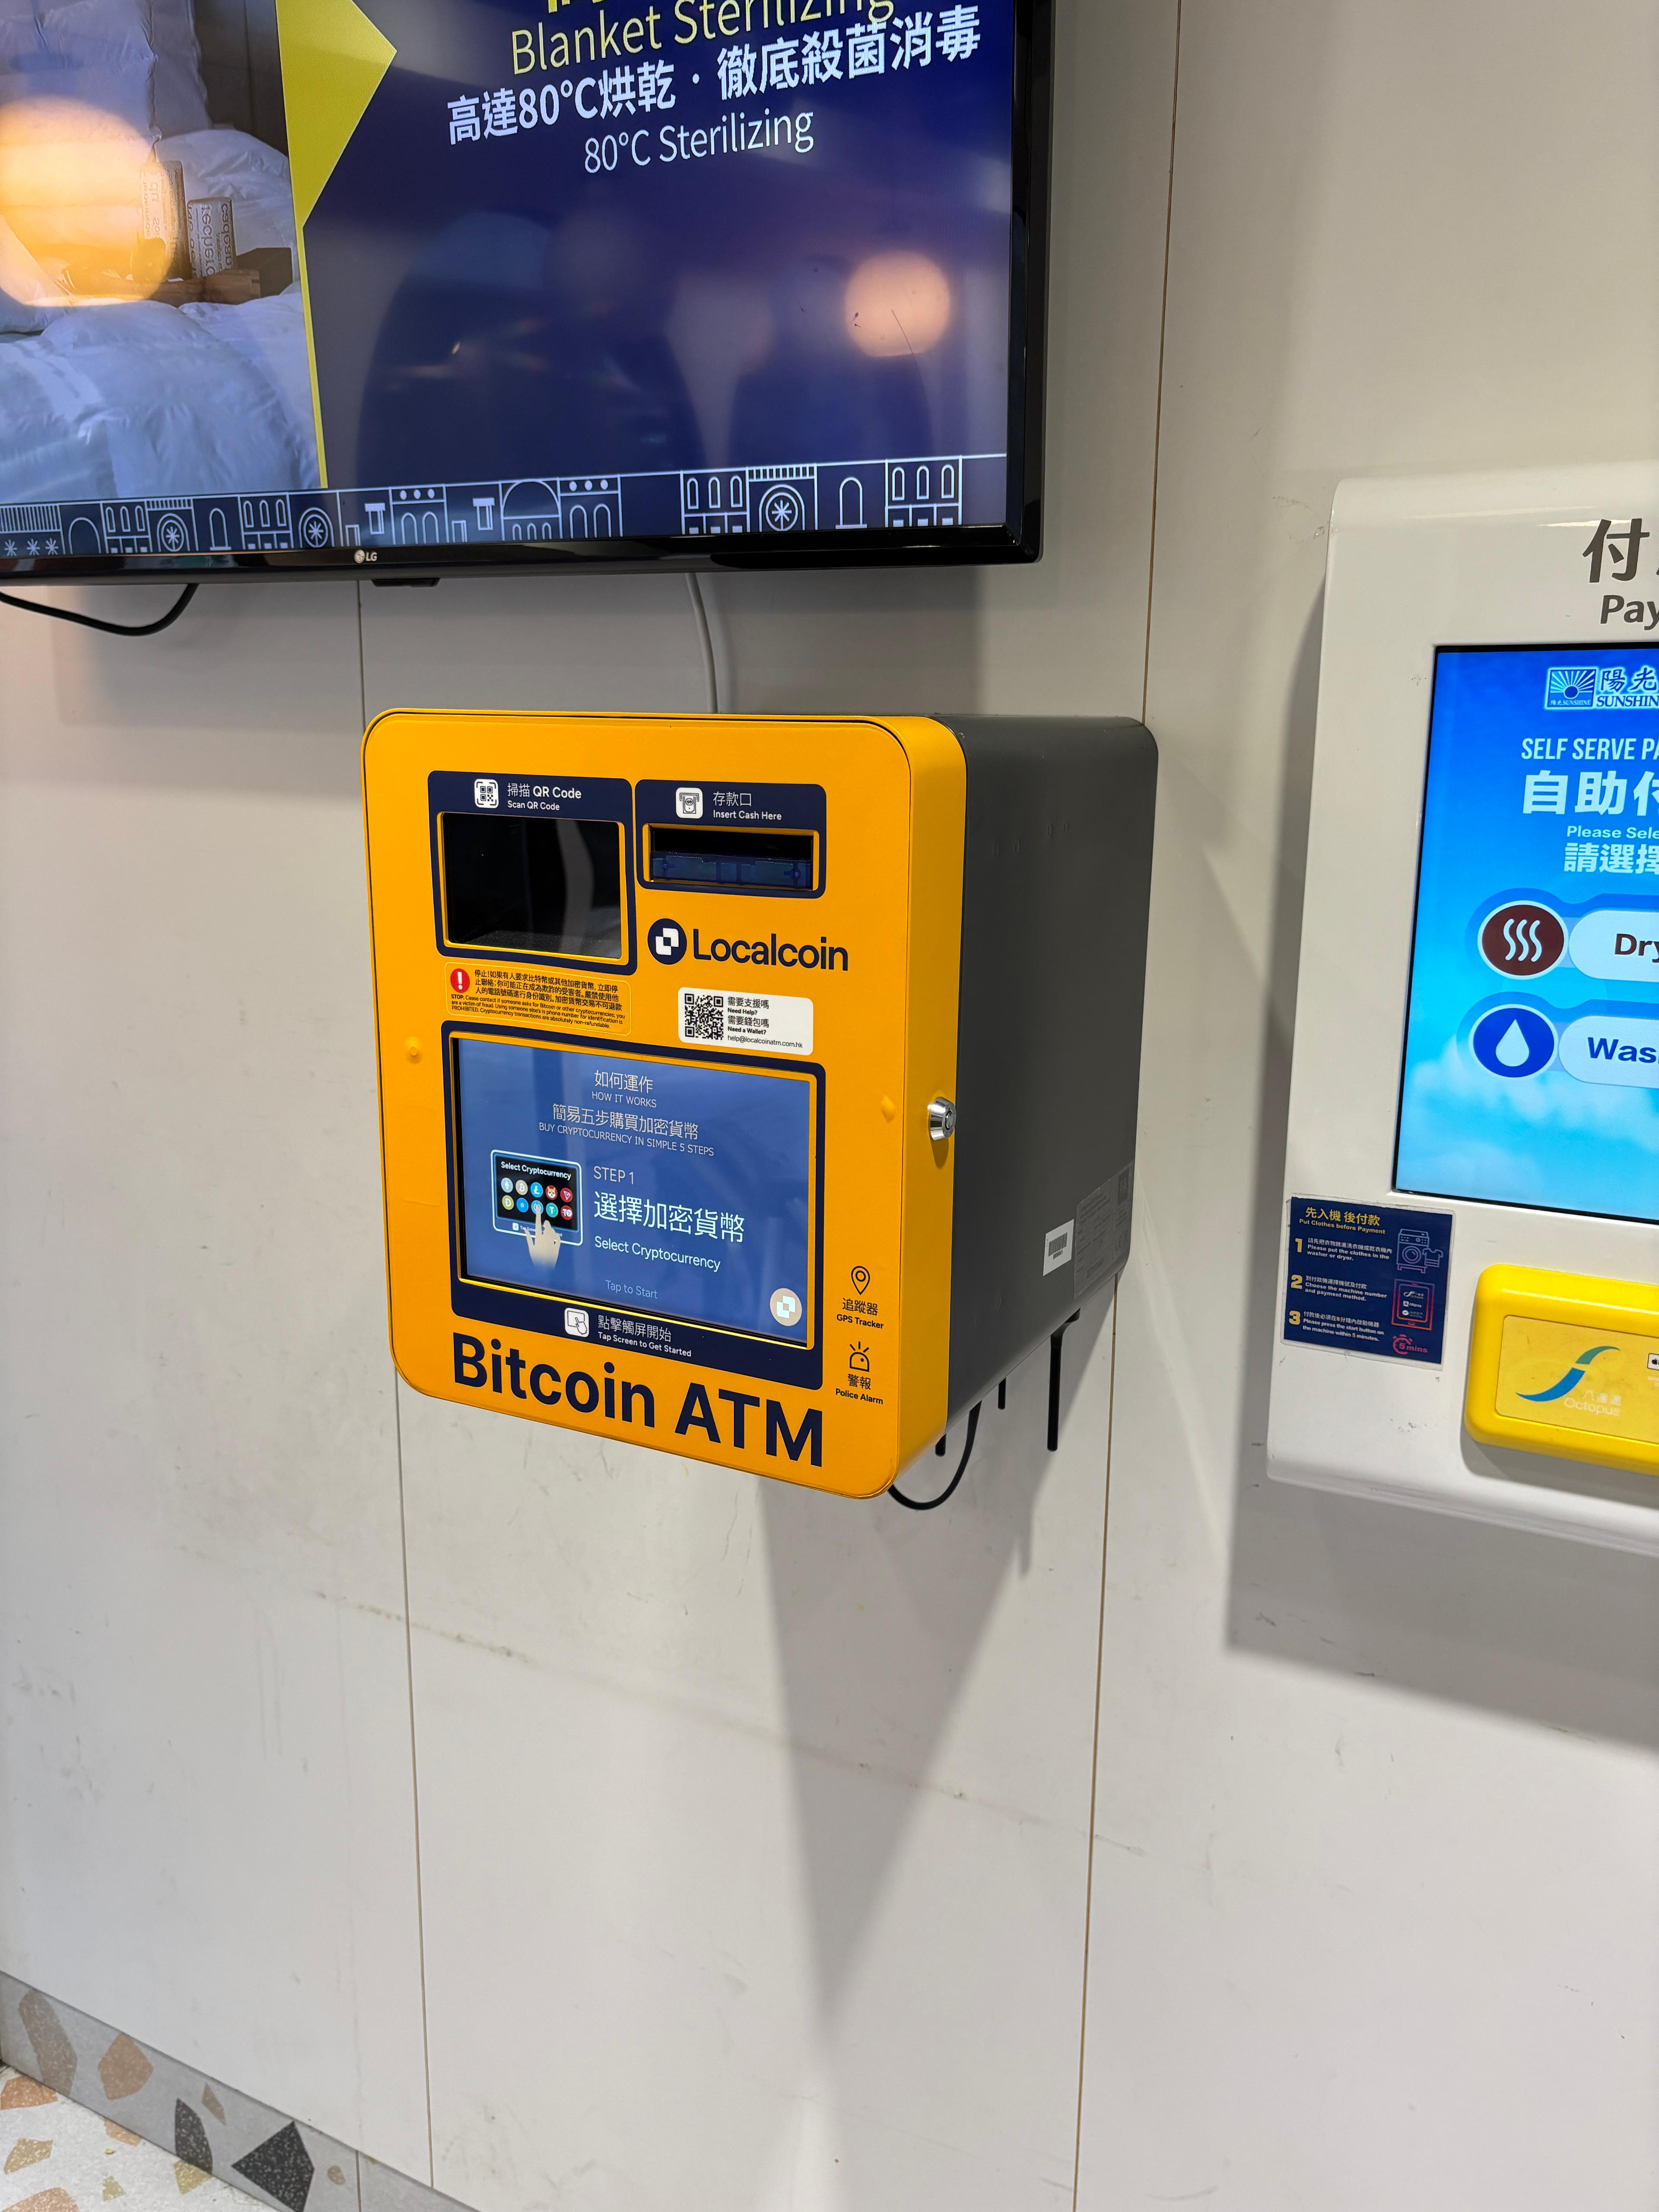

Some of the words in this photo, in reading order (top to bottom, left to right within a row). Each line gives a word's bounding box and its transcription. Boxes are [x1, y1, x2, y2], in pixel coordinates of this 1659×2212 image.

[512, 6, 662, 74] Blanket
[585, 130, 651, 173] 80°C
[659, 108, 814, 163] Sterilizing
[365, 552, 377, 562] LG
[1583, 518, 1659, 583] 付
[1601, 667, 1657, 692] 陽光
[1521, 738, 1568, 760] SELF
[1572, 738, 1637, 760] SERVE
[507, 783, 530, 798] 掃描
[533, 786, 550, 798] QR
[552, 786, 582, 799] Code
[713, 791, 752, 807] 存款口
[507, 800, 525, 809] Scan
[527, 802, 538, 810] QR
[540, 802, 560, 810] Code
[713, 810, 737, 819] Insert
[738, 810, 759, 820] Cash
[761, 811, 782, 820] Here
[1567, 825, 1621, 838] Please
[693, 928, 848, 971] Localcoin
[728, 996, 769, 1009] 需要支援嗎
[480, 1007, 513, 1017] Cryptocurrency
[728, 1015, 769, 1028] 需要錢包嗎
[728, 1035, 803, 1048] help@localcoinatm.com.hk
[1588, 1037, 1659, 1063] Was
[594, 1069, 654, 1093] 如何運作
[592, 1091, 612, 1102] HOW
[615, 1094, 623, 1103] IT
[626, 1096, 657, 1108] WORKS
[553, 1103, 698, 1140] 簡易五步購買加密貨幣
[539, 1122, 555, 1132] BUY
[557, 1125, 632, 1144] CRYPTOCURRENCY
[635, 1136, 644, 1146] IN
[647, 1138, 677, 1151] SIMPLE
[680, 1142, 685, 1152] 5
[687, 1144, 714, 1157] STEPS
[501, 1161, 521, 1171] Select
[521, 1164, 572, 1181] Cryptocurrency
[594, 1166, 625, 1183] STEP
[629, 1171, 634, 1185] 1
[594, 1191, 745, 1243] 選擇加密貨幣
[1305, 1207, 1341, 1222] 先入機
[1344, 1211, 1380, 1227] 後付款
[1336, 1223, 1356, 1231] before
[1357, 1226, 1386, 1234] Payment
[1295, 1238, 1303, 1253] 1
[594, 1236, 629, 1253] Select
[632, 1243, 721, 1273] Cryptocurrency
[605, 1280, 622, 1293] Tap
[623, 1283, 633, 1294] to
[636, 1286, 658, 1299] Start
[1290, 1274, 1303, 1290] 2
[1338, 1287, 1363, 1295] machine
[836, 1314, 853, 1323] GPS
[855, 1317, 884, 1329] Tracker
[1289, 1310, 1300, 1325] 3
[598, 1315, 671, 1342] 點擊觸屏開始
[1312, 1326, 1334, 1335] machine
[598, 1331, 611, 1342] Tap
[613, 1335, 638, 1346] Screen
[639, 1340, 647, 1348] to
[648, 1342, 662, 1351] Get
[664, 1345, 692, 1357] Started
[1406, 1345, 1428, 1353] mins
[848, 1373, 871, 1390] 警報
[453, 1332, 655, 1428] Bitcoin
[674, 1382, 823, 1468] ATM
[836, 1388, 858, 1399] Police
[860, 1393, 884, 1405] Alarm
[1564, 1397, 1621, 1416] Octopus
